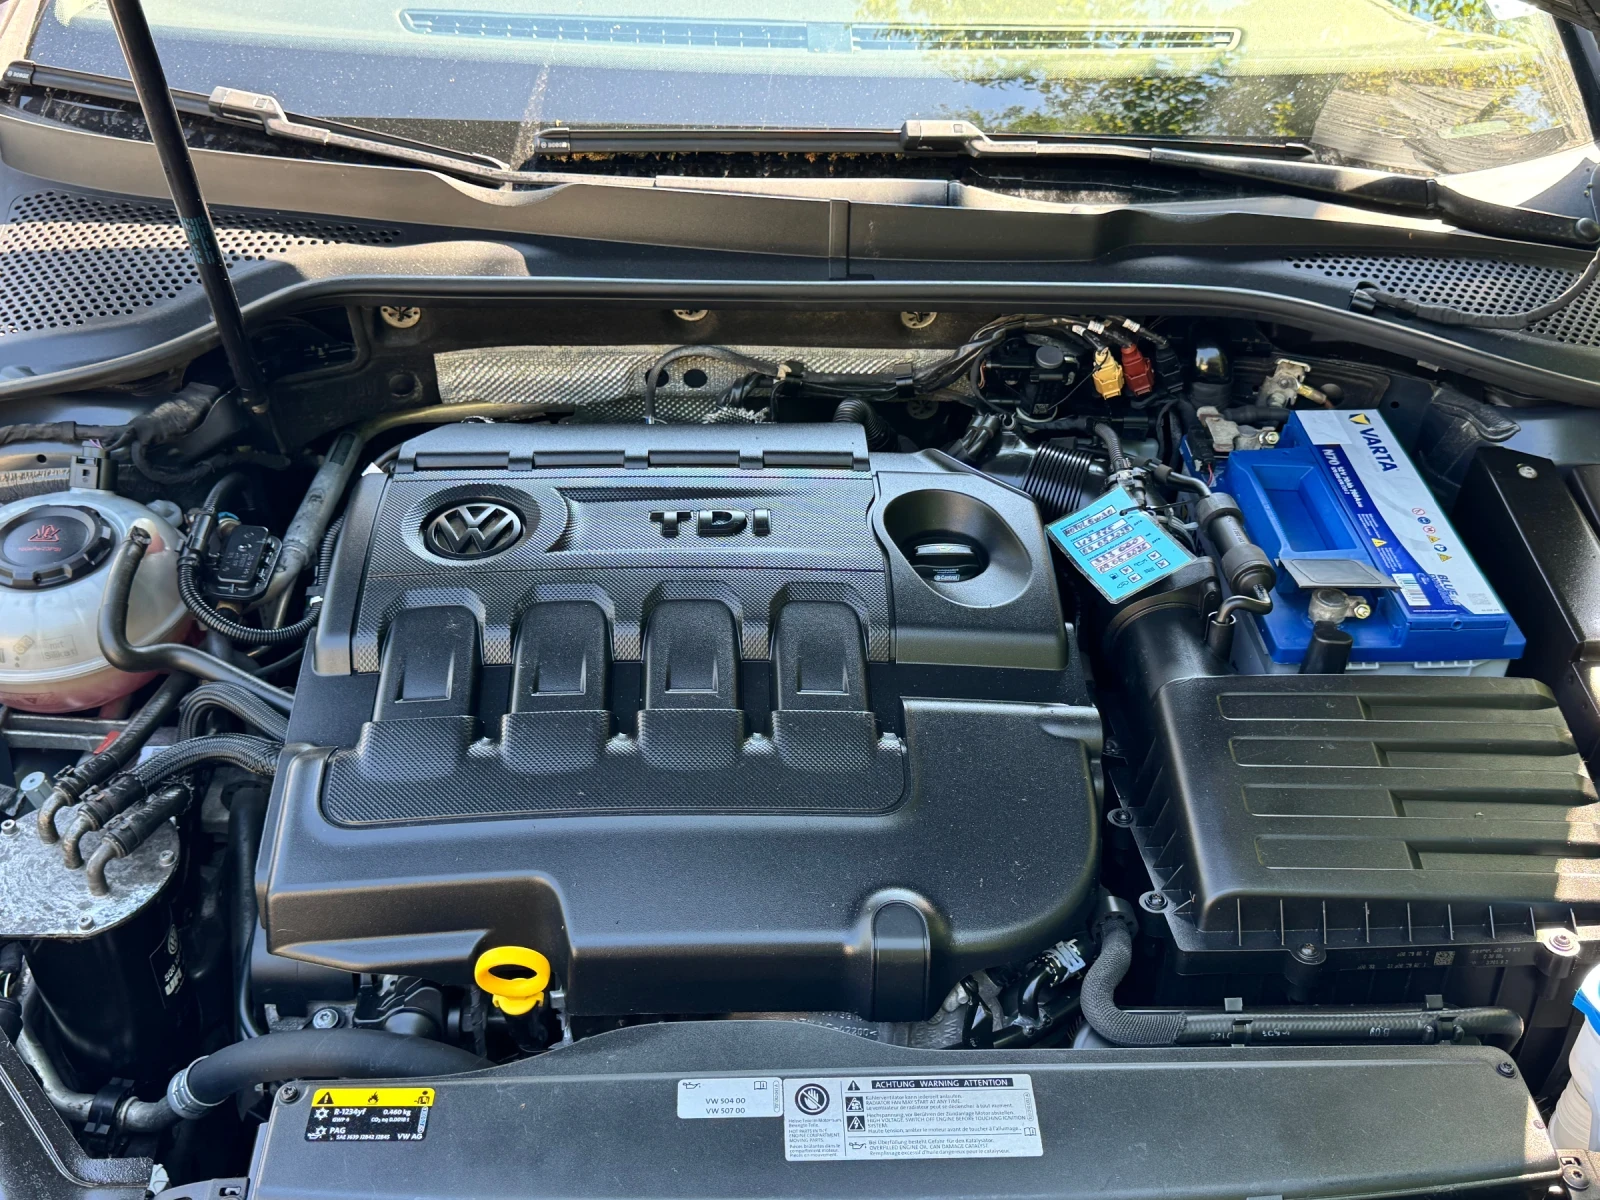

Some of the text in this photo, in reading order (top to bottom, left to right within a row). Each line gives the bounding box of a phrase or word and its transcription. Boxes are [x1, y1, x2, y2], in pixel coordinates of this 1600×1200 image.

[1322, 449, 1340, 466] N70
[1360, 428, 1398, 472] VARTA
[649, 509, 772, 537] TDI
[920, 1080, 960, 1088] WARNING
[334, 1108, 367, 1116] R-1234yf
